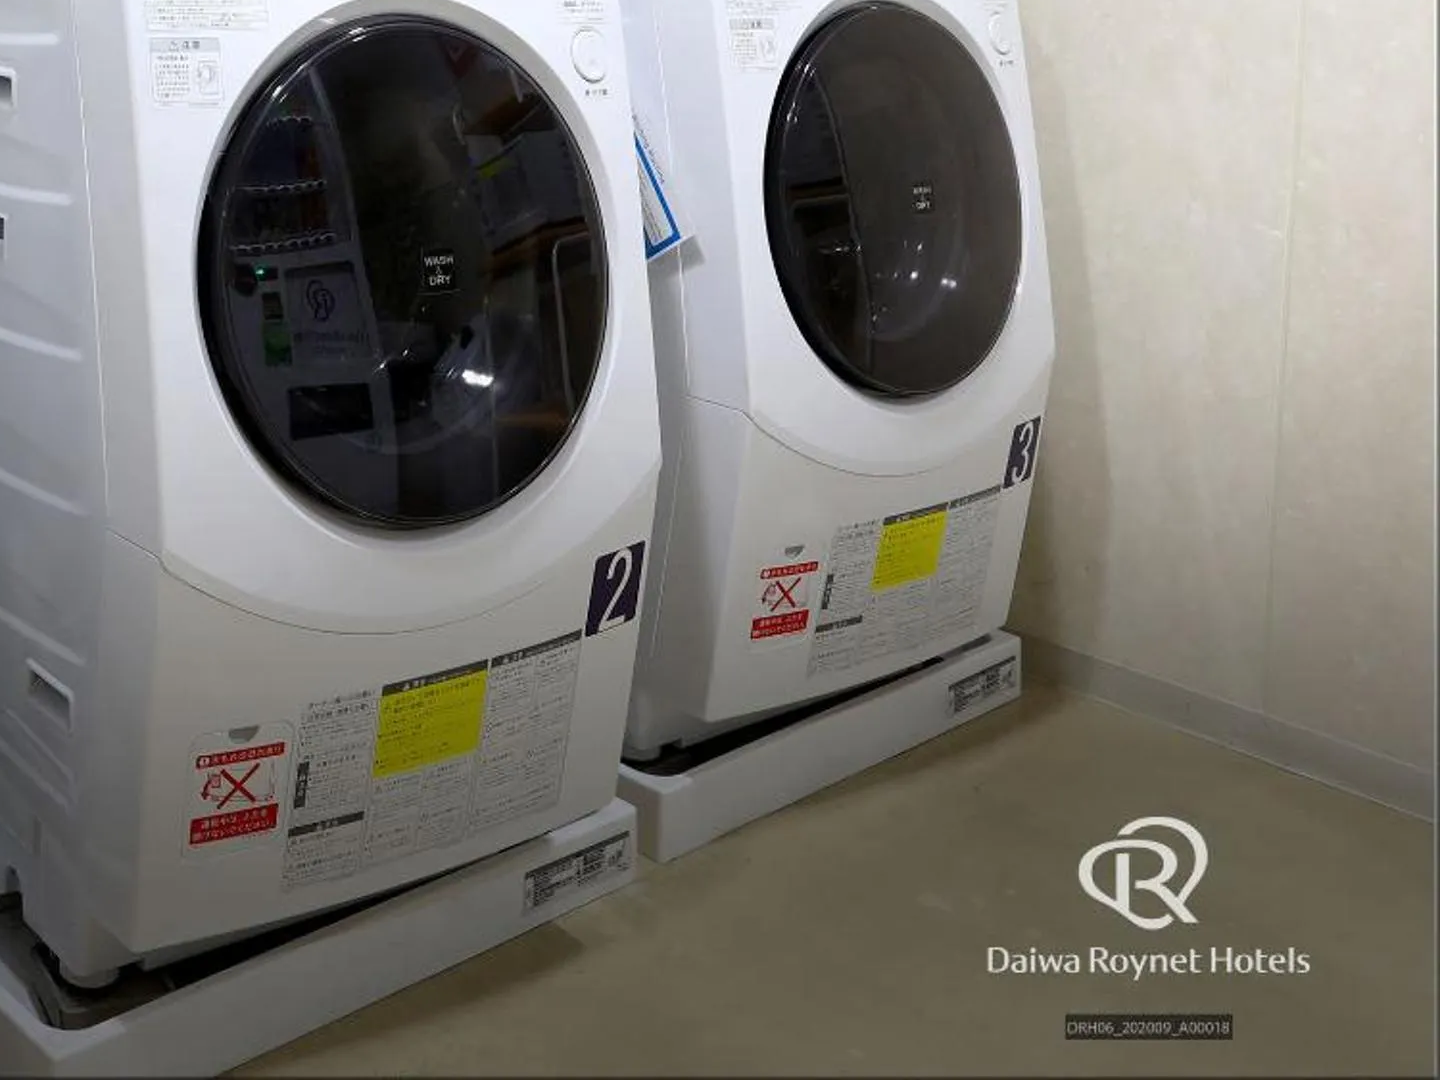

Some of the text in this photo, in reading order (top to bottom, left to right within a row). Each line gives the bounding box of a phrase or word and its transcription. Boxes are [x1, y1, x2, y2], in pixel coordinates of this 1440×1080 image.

[424, 256, 454, 267] WASH
[429, 275, 450, 286] DRY
[1011, 421, 1035, 484] 3
[599, 547, 633, 631] 2
